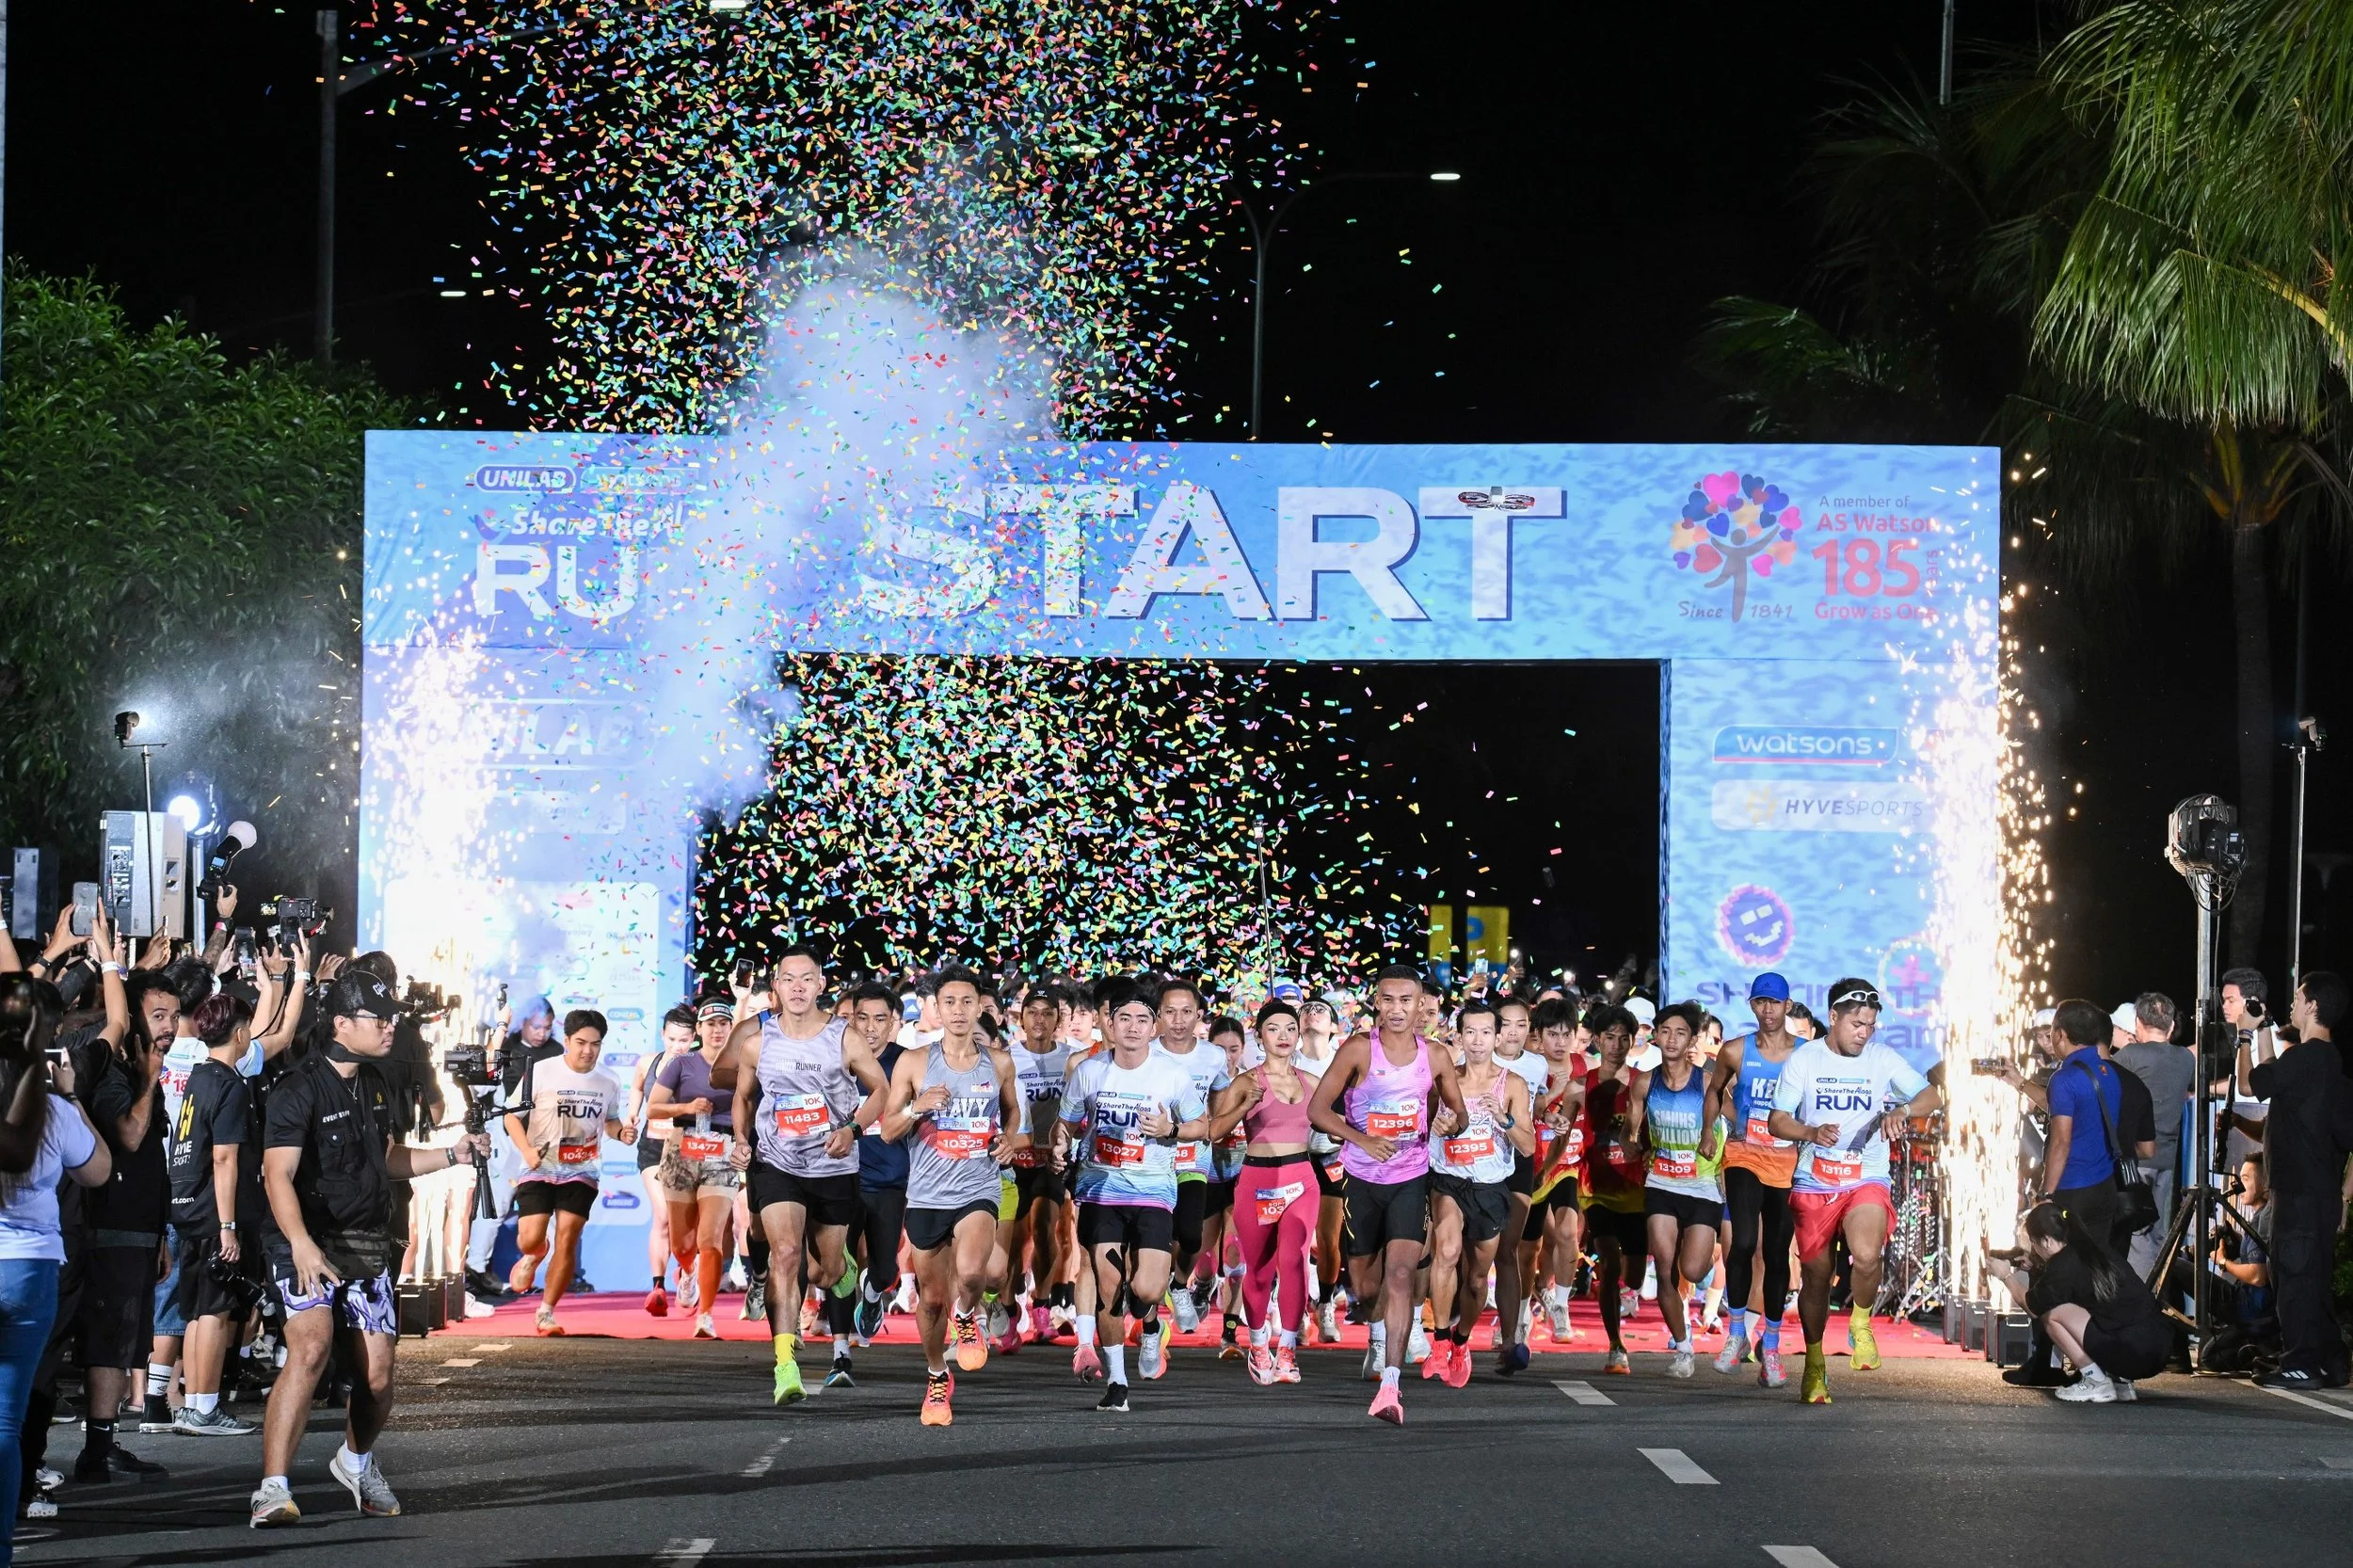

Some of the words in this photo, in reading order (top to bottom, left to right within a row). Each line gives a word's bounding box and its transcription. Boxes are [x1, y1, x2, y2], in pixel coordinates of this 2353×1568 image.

[484, 471, 567, 488] UNILAB
[1819, 496, 1829, 507] A
[1834, 495, 1891, 508] member
[1896, 495, 1911, 508] of
[1817, 513, 1848, 532] AS
[858, 481, 1567, 622] START
[1811, 537, 1922, 598] 185
[475, 543, 664, 619] RU
[1678, 600, 1723, 618] Since
[1751, 603, 1793, 618] 1841
[1815, 601, 1867, 619] Grow
[1871, 606, 1892, 619] as
[1737, 732, 1873, 755] watsons
[1785, 798, 1924, 817] HYVESPORTS
[795, 1062, 823, 1072] RUNNER
[804, 1096, 822, 1105] 10K
[1816, 1095, 1872, 1111] RUN
[557, 1106, 602, 1119] RUN
[784, 1112, 821, 1125] 11483
[1373, 1118, 1414, 1128] 12396
[943, 1139, 984, 1148] 10325
[1126, 1133, 1142, 1142] 10K
[687, 1142, 718, 1151] 13477
[1102, 1143, 1138, 1157] 13027
[1449, 1143, 1487, 1154] 12395
[1658, 1162, 1691, 1174] 13209
[1821, 1164, 1852, 1176] 13116
